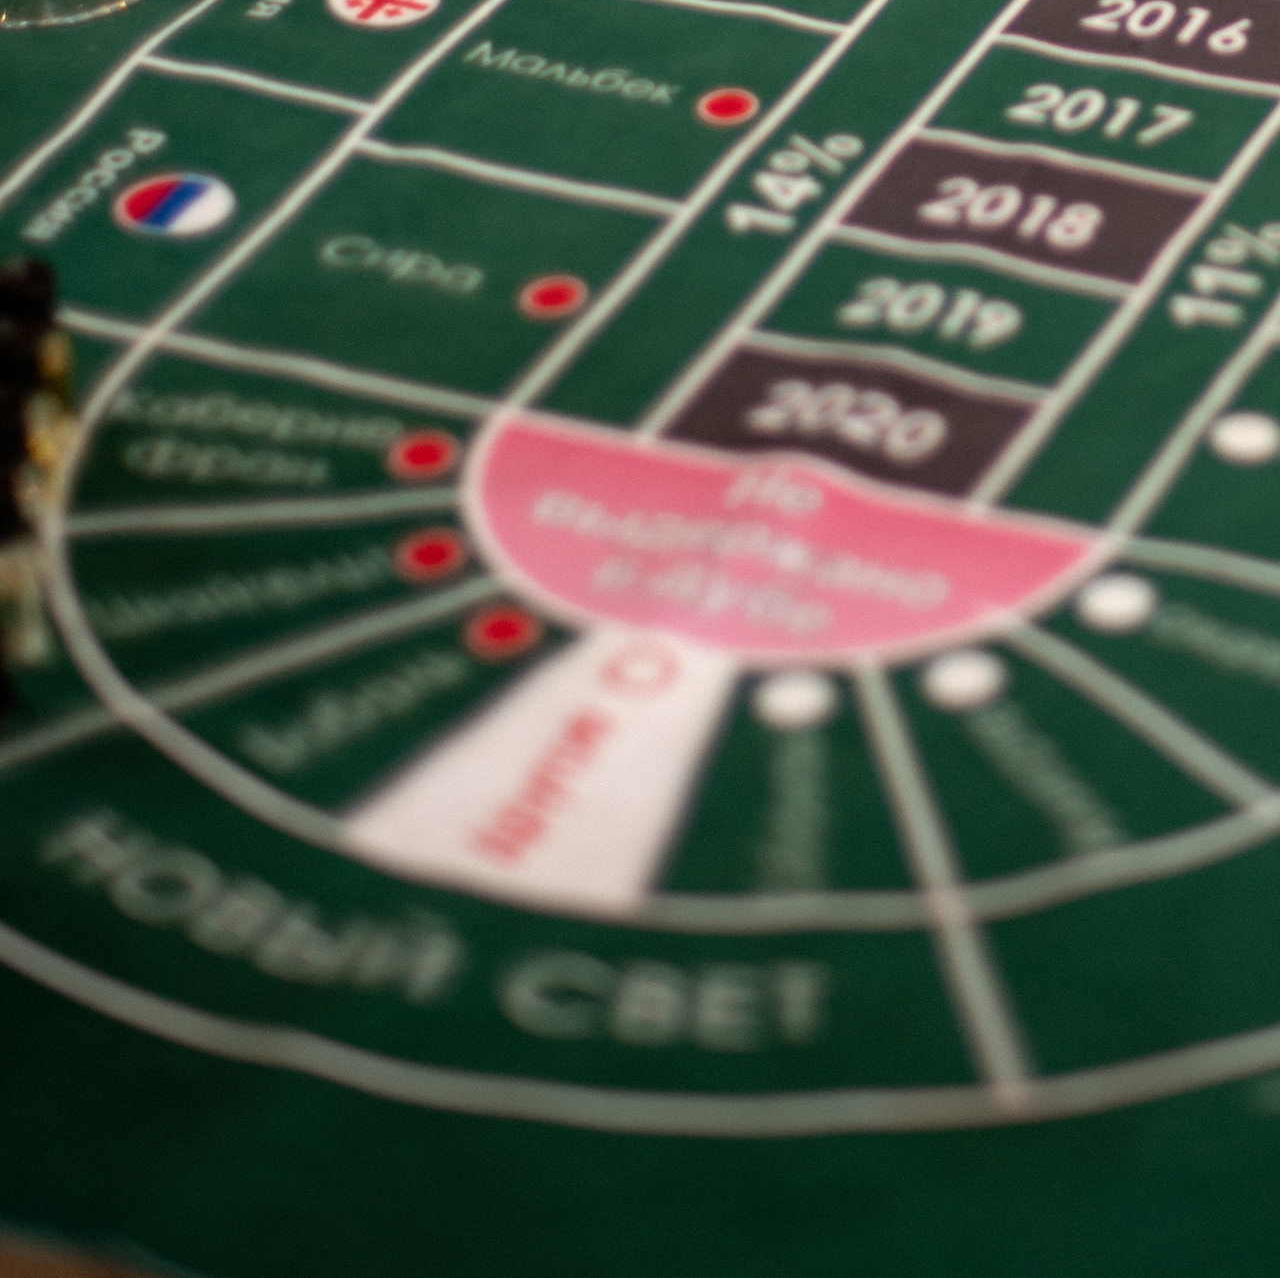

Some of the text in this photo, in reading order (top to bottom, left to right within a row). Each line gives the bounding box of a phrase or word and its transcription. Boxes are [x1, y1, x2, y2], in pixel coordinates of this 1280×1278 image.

[461, 38, 687, 107] Мальбек
[1006, 83, 1196, 145] 2017
[20, 127, 169, 244] Россия
[722, 131, 865, 235] 14%
[917, 175, 1106, 250] 2018
[317, 235, 487, 296] Сира
[835, 277, 1024, 350] 2019
[744, 379, 948, 464] 2020
[494, 947, 828, 1051] СВЕТ
